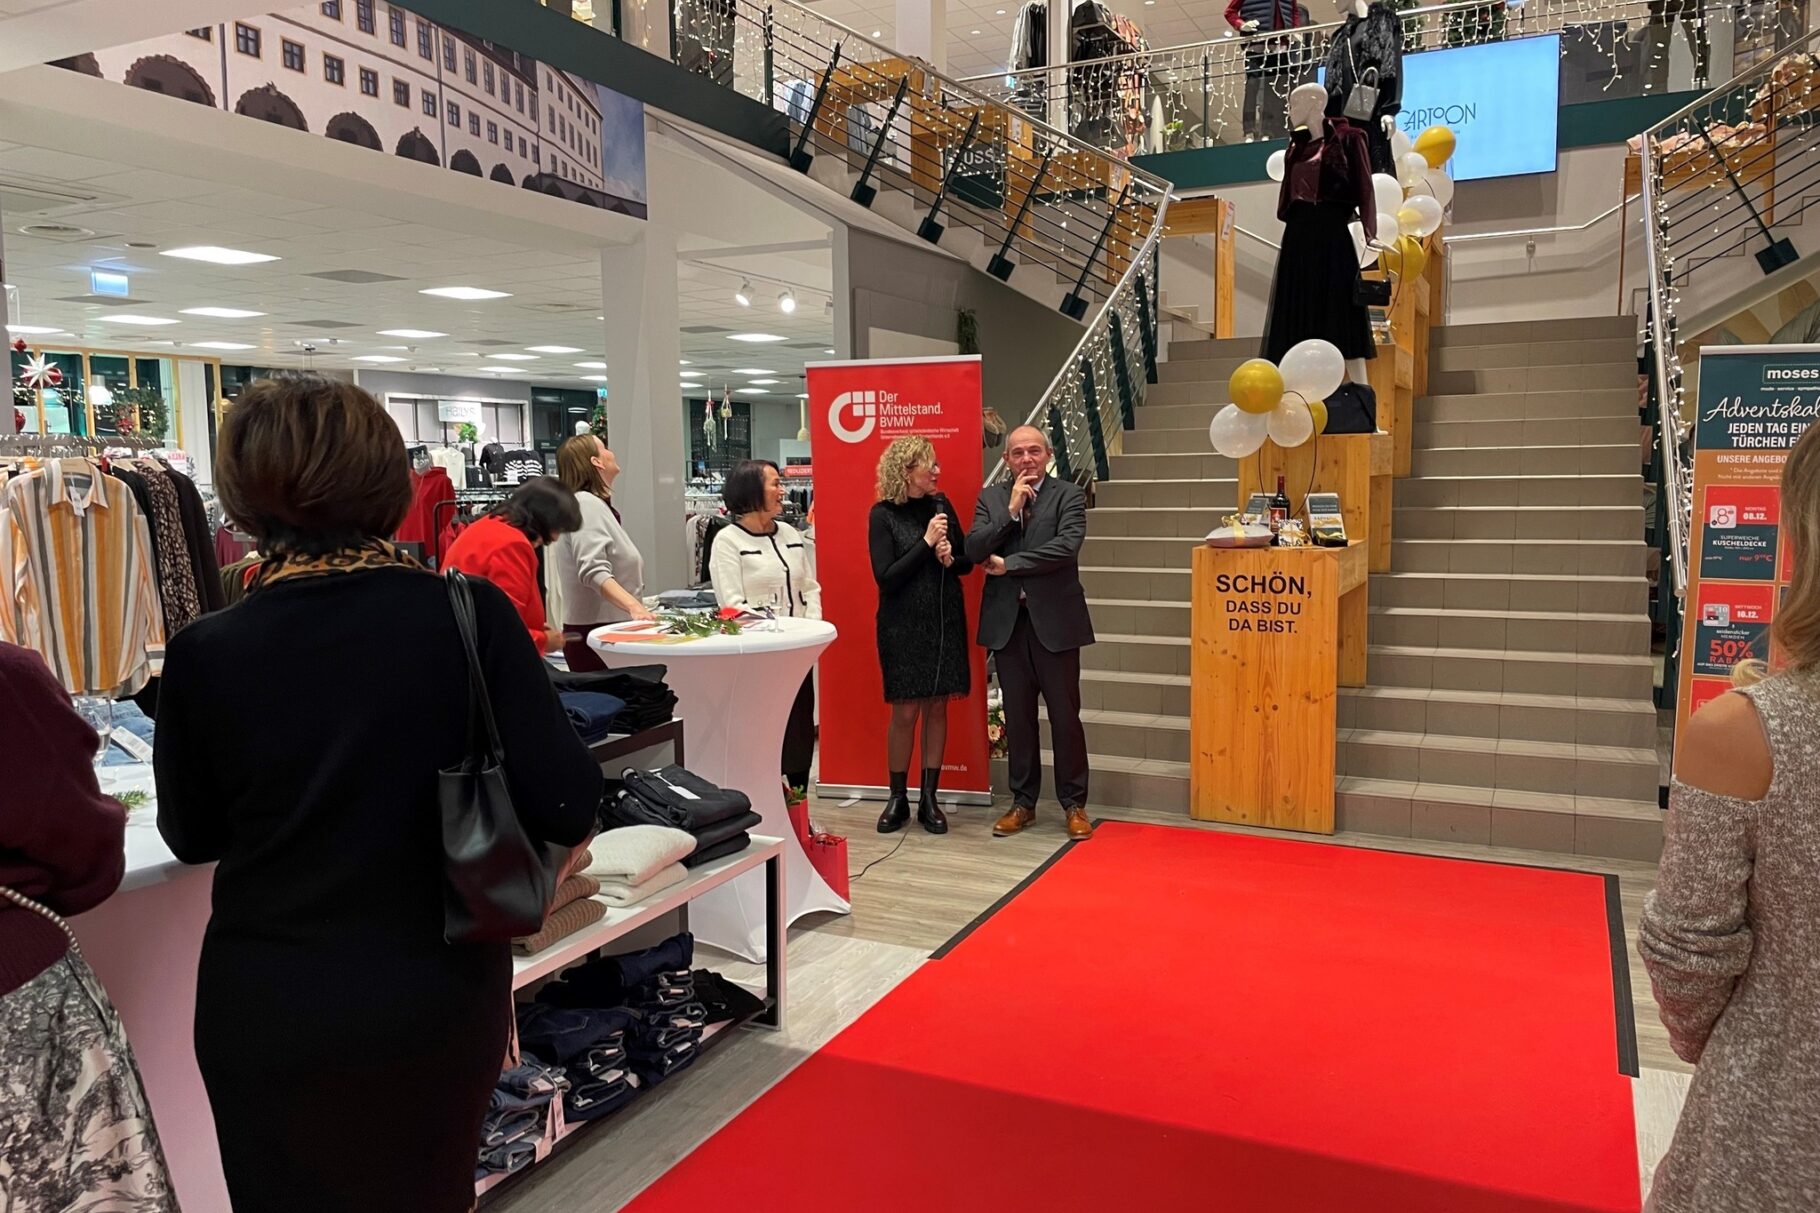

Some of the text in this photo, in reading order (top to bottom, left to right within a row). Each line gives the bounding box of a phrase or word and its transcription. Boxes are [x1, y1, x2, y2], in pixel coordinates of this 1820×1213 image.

[1400, 103, 1476, 131] CARTOON
[1767, 369, 1819, 379] moses
[879, 390, 898, 403] Der
[879, 402, 943, 416] Mittelstand.
[880, 416, 915, 428] BVMW
[1727, 423, 1763, 434] JEDEN
[1766, 423, 1788, 434] TAG
[1732, 435, 1800, 448] TÜRCHEN F
[1717, 455, 1788, 464] UNSERE ANGEBO
[1743, 512, 1767, 520] 08.12.
[1216, 571, 1312, 599] SCHÖN,
[1226, 600, 1301, 615] DASS DU
[1229, 618, 1298, 634] DA BIST.
[1710, 639, 1754, 658] 50%
[1709, 656, 1740, 665] RABA
